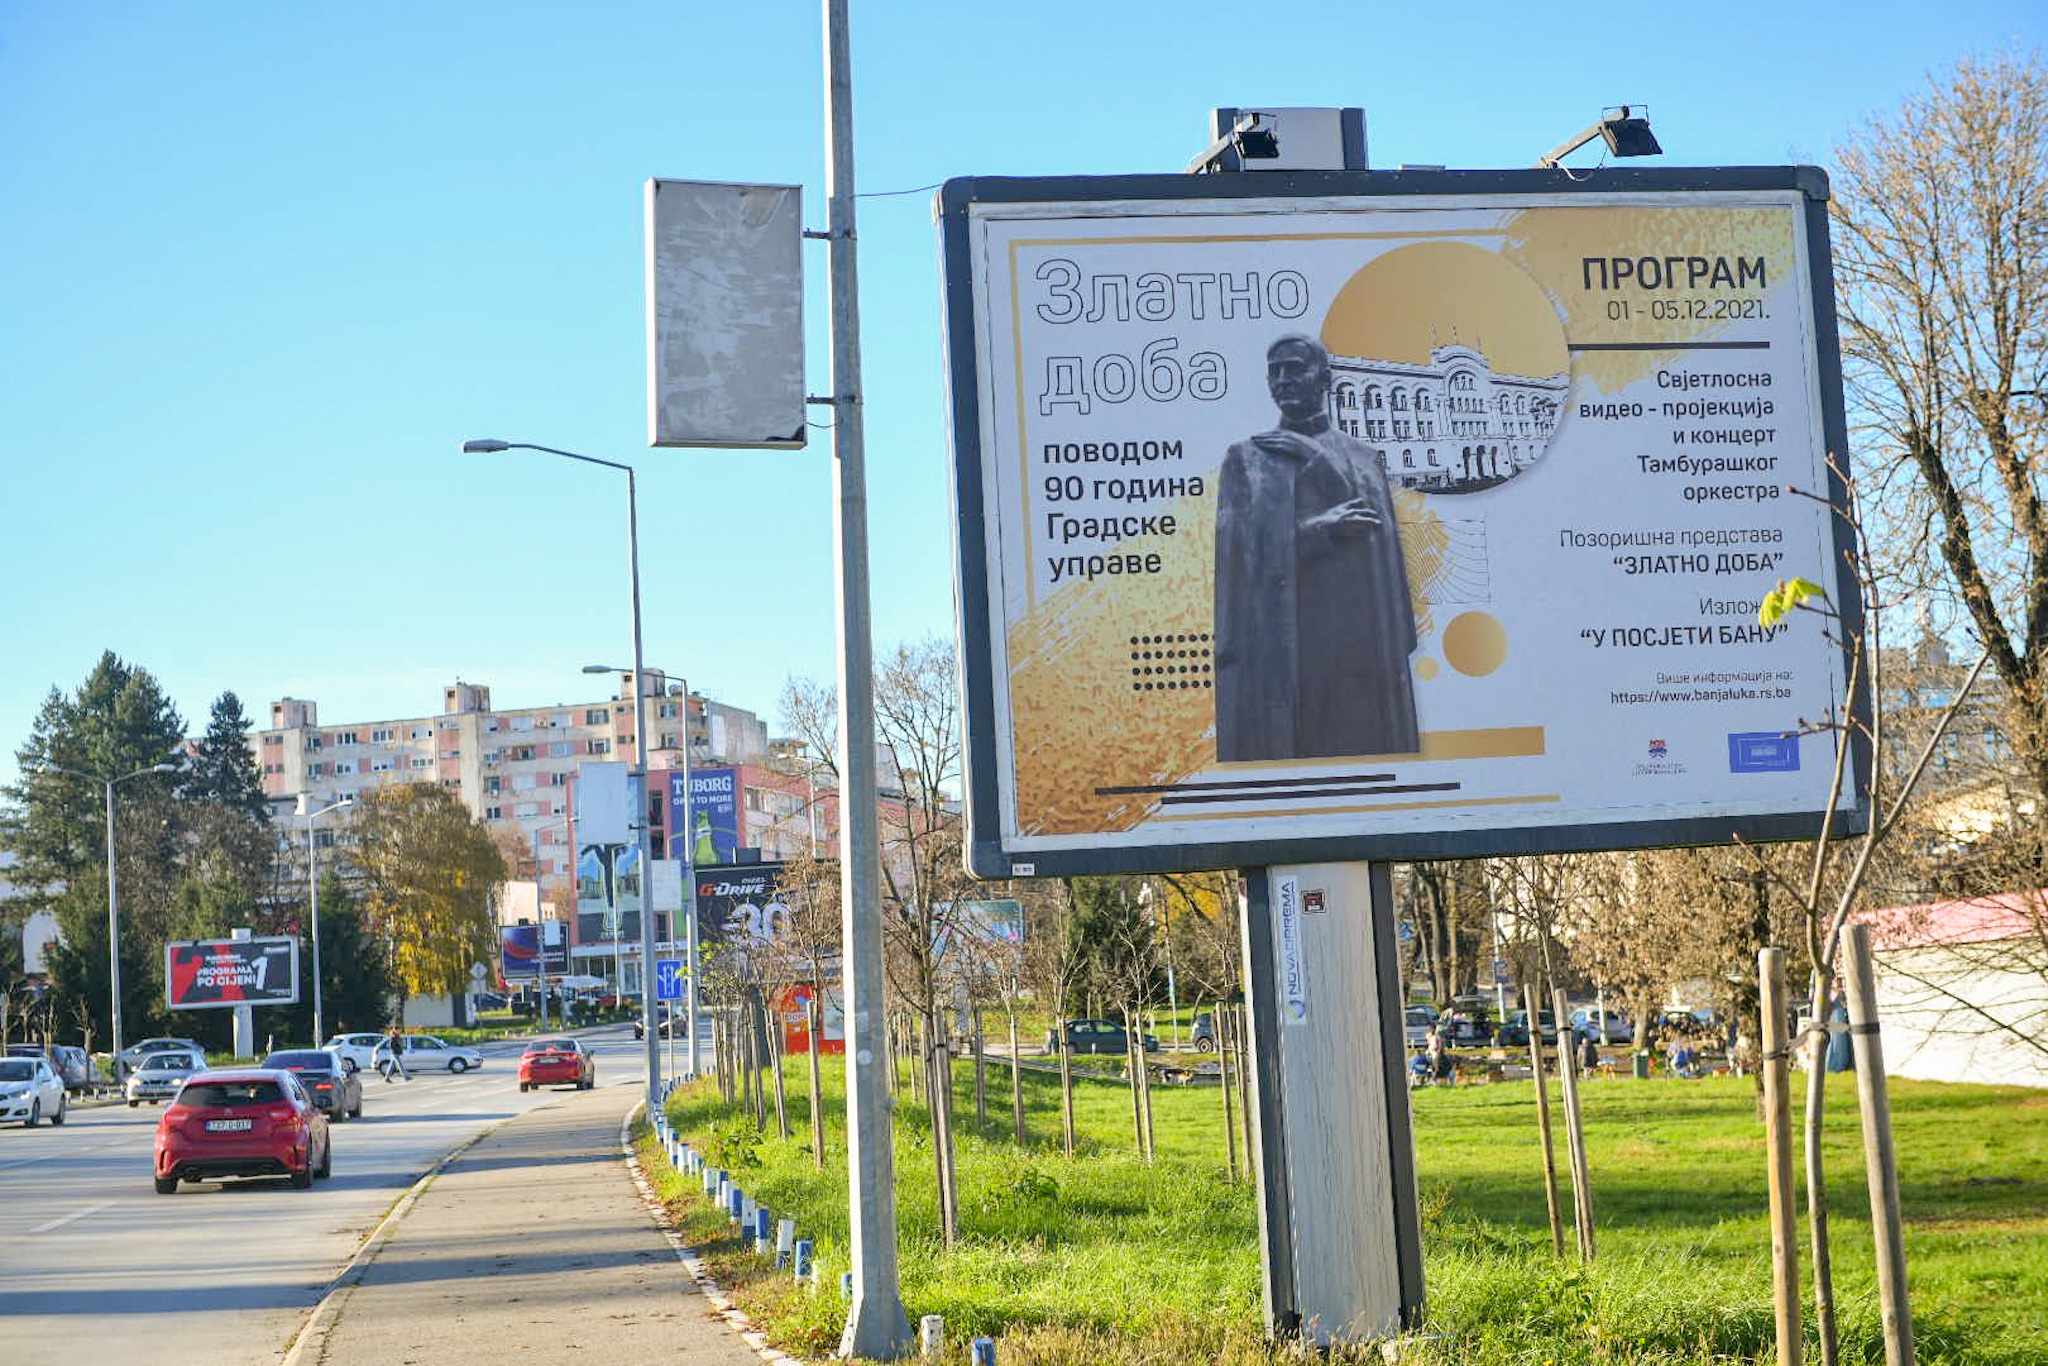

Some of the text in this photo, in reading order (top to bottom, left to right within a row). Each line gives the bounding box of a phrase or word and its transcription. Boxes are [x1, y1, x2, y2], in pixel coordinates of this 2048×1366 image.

[1583, 256, 1766, 290] ПРОГРАМ
[1036, 259, 1308, 324] Златно
[1607, 300, 1629, 321] 01
[1652, 299, 1770, 320] 05.12.2021.
[1039, 337, 1227, 415] доба
[1657, 370, 1772, 391] Свјетлосна
[1579, 403, 1643, 420] видео
[1663, 397, 1774, 419] пројекција
[1673, 428, 1776, 446] и концерт
[1044, 440, 1182, 465] поводом
[1637, 455, 1778, 475] Тамбурашког
[1045, 476, 1204, 503] 90 година
[1683, 485, 1780, 503] оркестра
[1047, 514, 1176, 544] Градске
[1560, 528, 1782, 551] Позоришна представа
[1048, 552, 1161, 582] управе
[1613, 552, 1783, 575] “ЗЛАТНО ДОБА”
[1612, 626, 1713, 647] ПОСЈЕТИ
[1656, 671, 1690, 685] Више
[1693, 668, 1773, 686] информација
[1611, 686, 1791, 704] https://www.banjaluka.rs.ba
[197, 964, 254, 976] PROGRAMA
[197, 977, 214, 988] PO
[217, 974, 256, 986] CIJENI
[251, 956, 268, 990] 1
